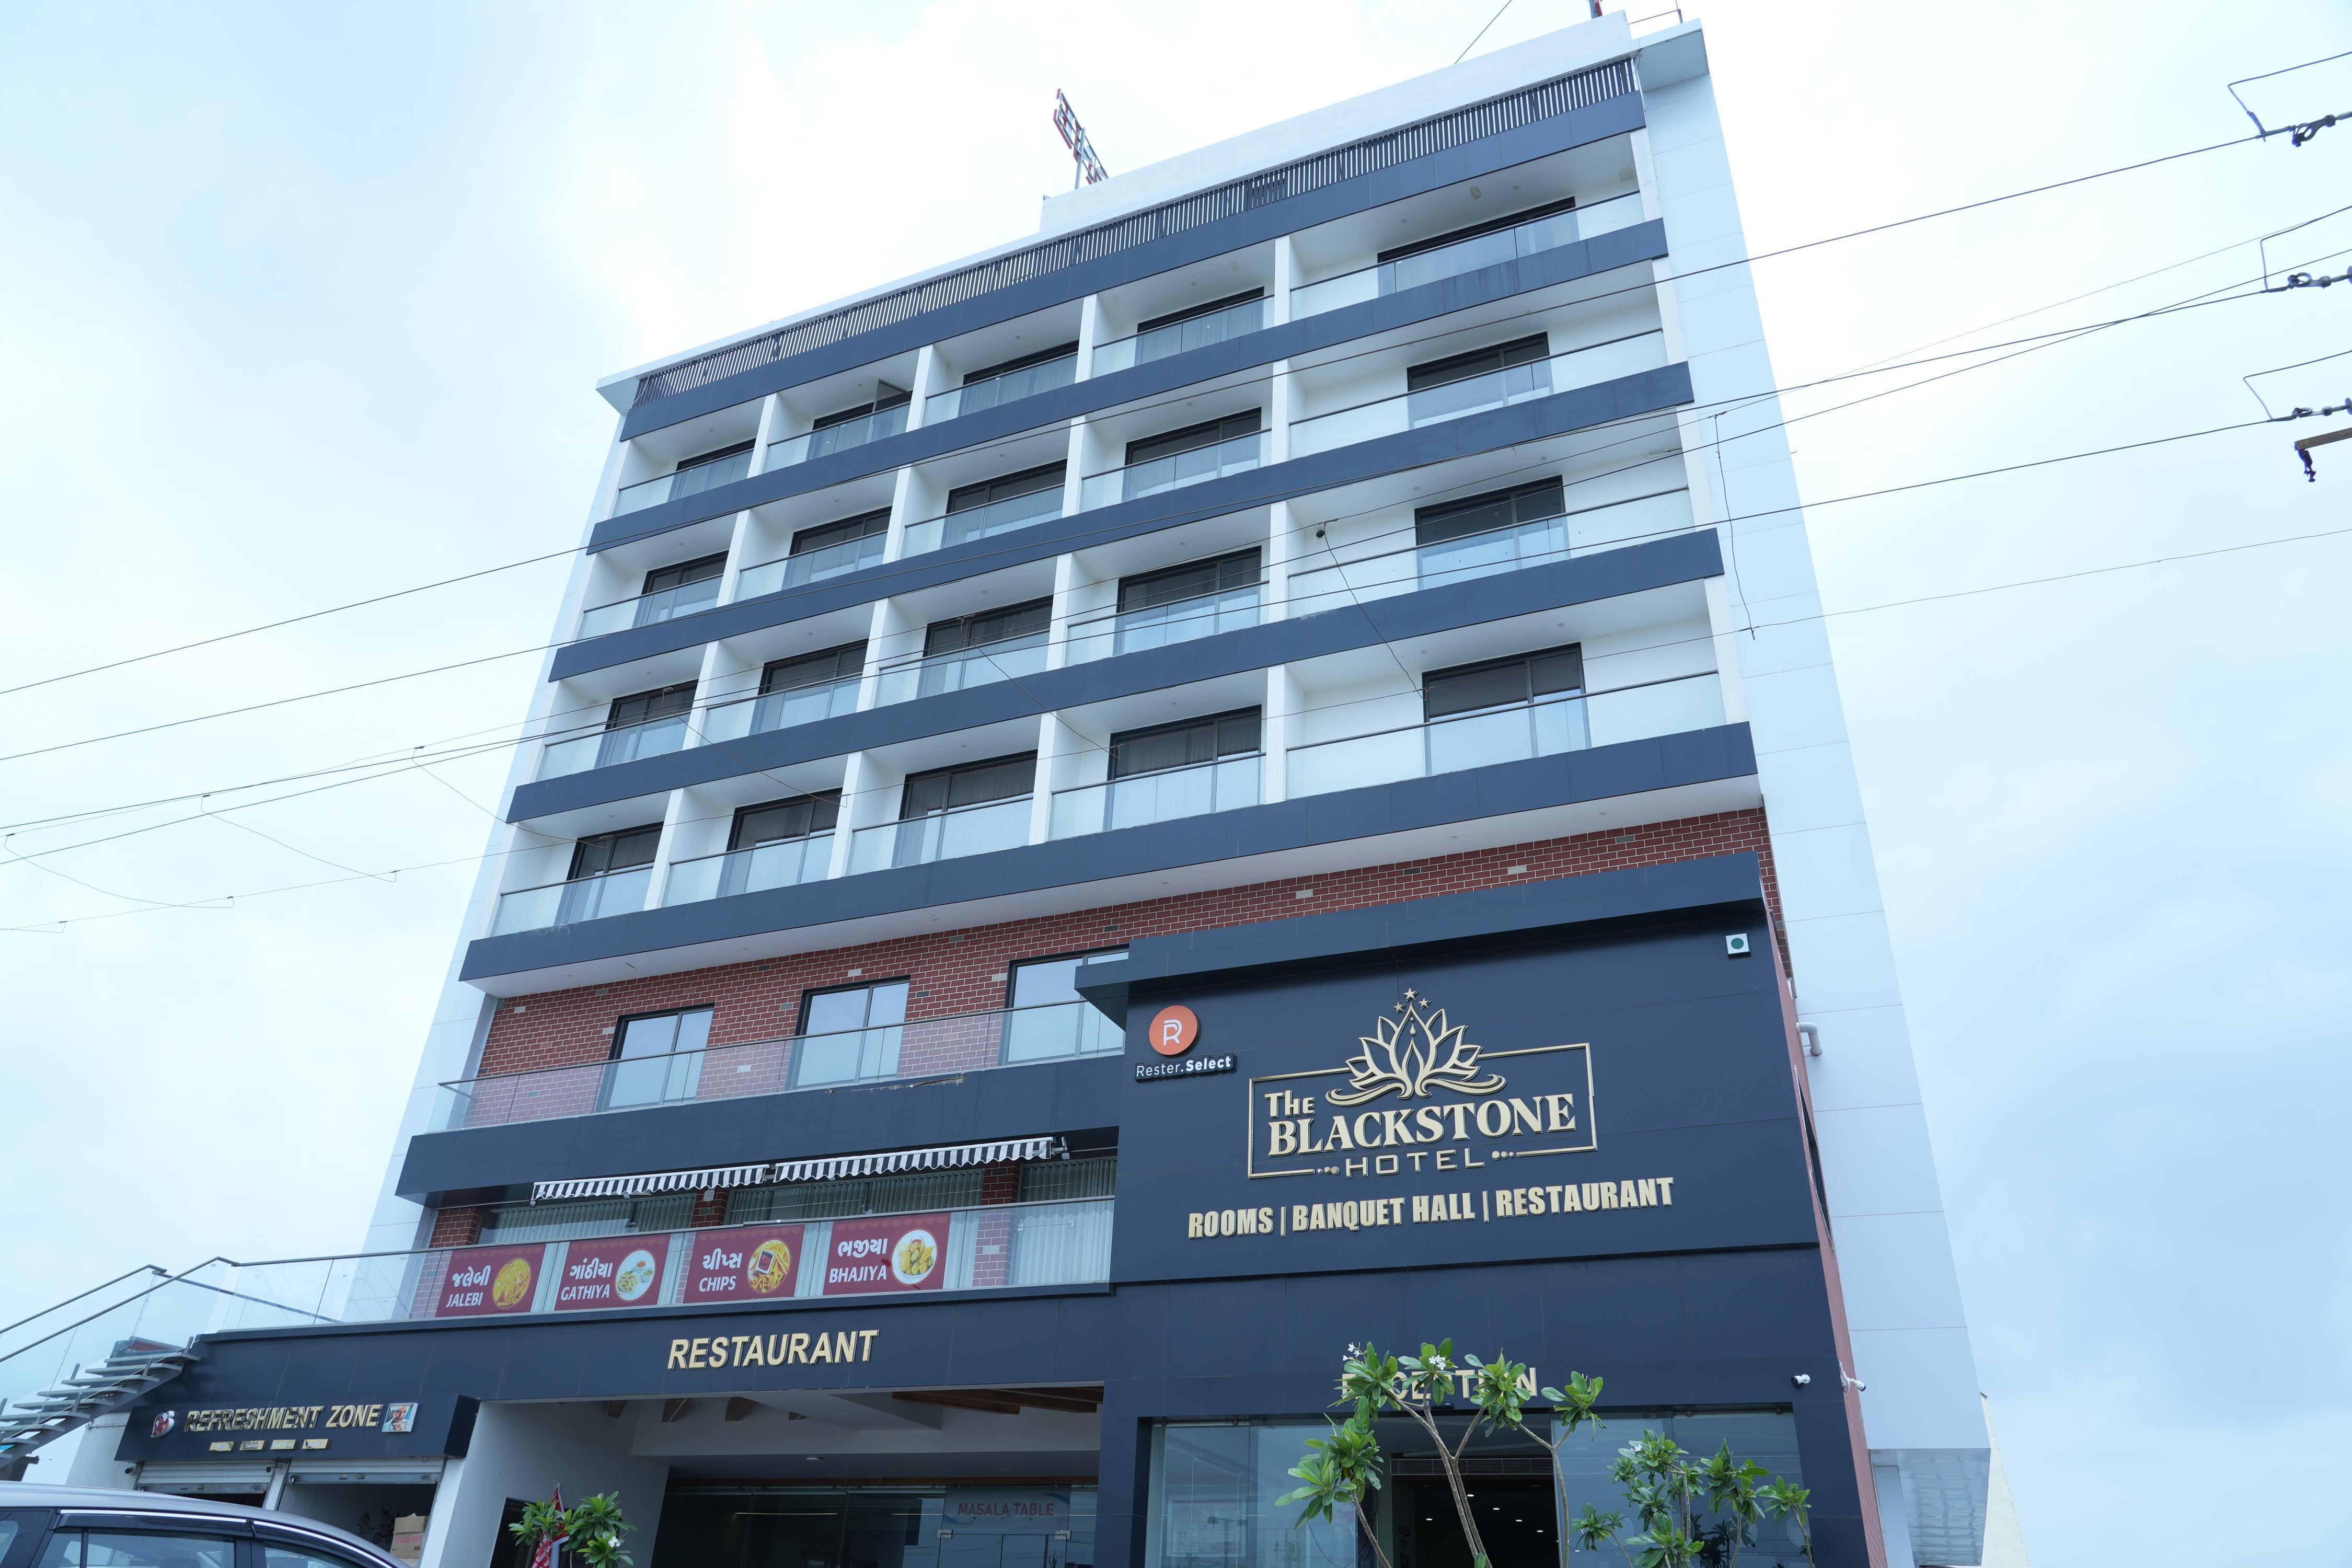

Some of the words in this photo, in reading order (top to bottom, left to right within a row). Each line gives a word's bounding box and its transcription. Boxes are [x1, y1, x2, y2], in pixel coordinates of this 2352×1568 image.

[1136, 1055, 1231, 1078] Rester.Select
[1264, 1089, 1316, 1118] The
[1267, 1093, 1576, 1158] BLACKSTONE
[1345, 1148, 1485, 1178] HOTEL
[1188, 1206, 1274, 1239] ROOMS
[1292, 1197, 1406, 1232] BANQUET
[1412, 1192, 1476, 1224] HALL
[1495, 1177, 1675, 1217] RESTAURANT
[837, 1238, 889, 1259] ભજીયા
[452, 1264, 492, 1288] જલેબી
[569, 1257, 614, 1280] ગાંઠીયા
[828, 1264, 887, 1284] BHAJIYA
[560, 1284, 610, 1301] GATHIYA
[698, 1275, 737, 1293] CHIPS
[445, 1292, 484, 1308] JALEBI
[667, 1329, 879, 1370] RESTAURANT
[184, 1405, 324, 1432] REFRESHMENT
[326, 1404, 384, 1428] ZONE
[958, 1503, 1010, 1516] MASALA
[1013, 1503, 1055, 1516] TABLE
